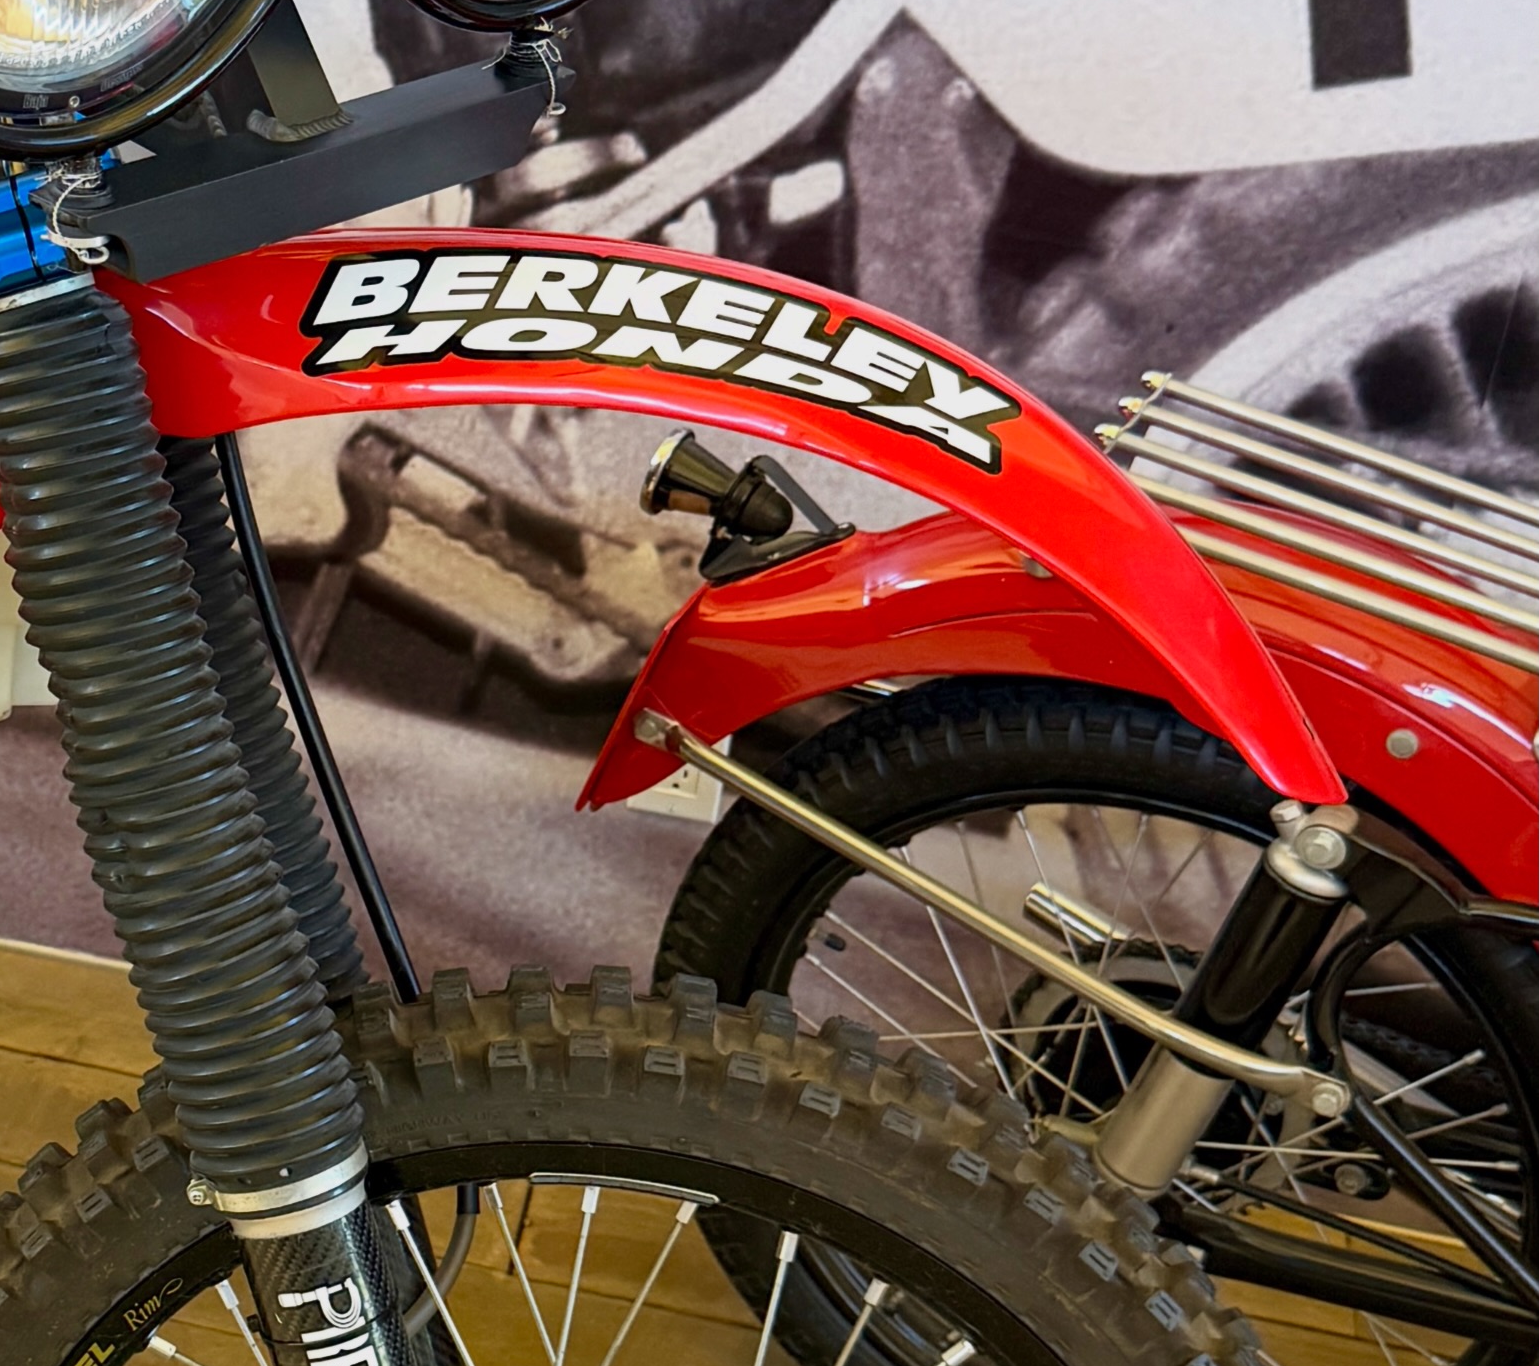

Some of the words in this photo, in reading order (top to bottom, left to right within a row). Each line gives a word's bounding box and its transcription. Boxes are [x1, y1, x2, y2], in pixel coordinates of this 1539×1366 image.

[313, 254, 1015, 420] BERKELEY
[320, 318, 994, 465] HONDA
[122, 1277, 184, 1333] Rim
